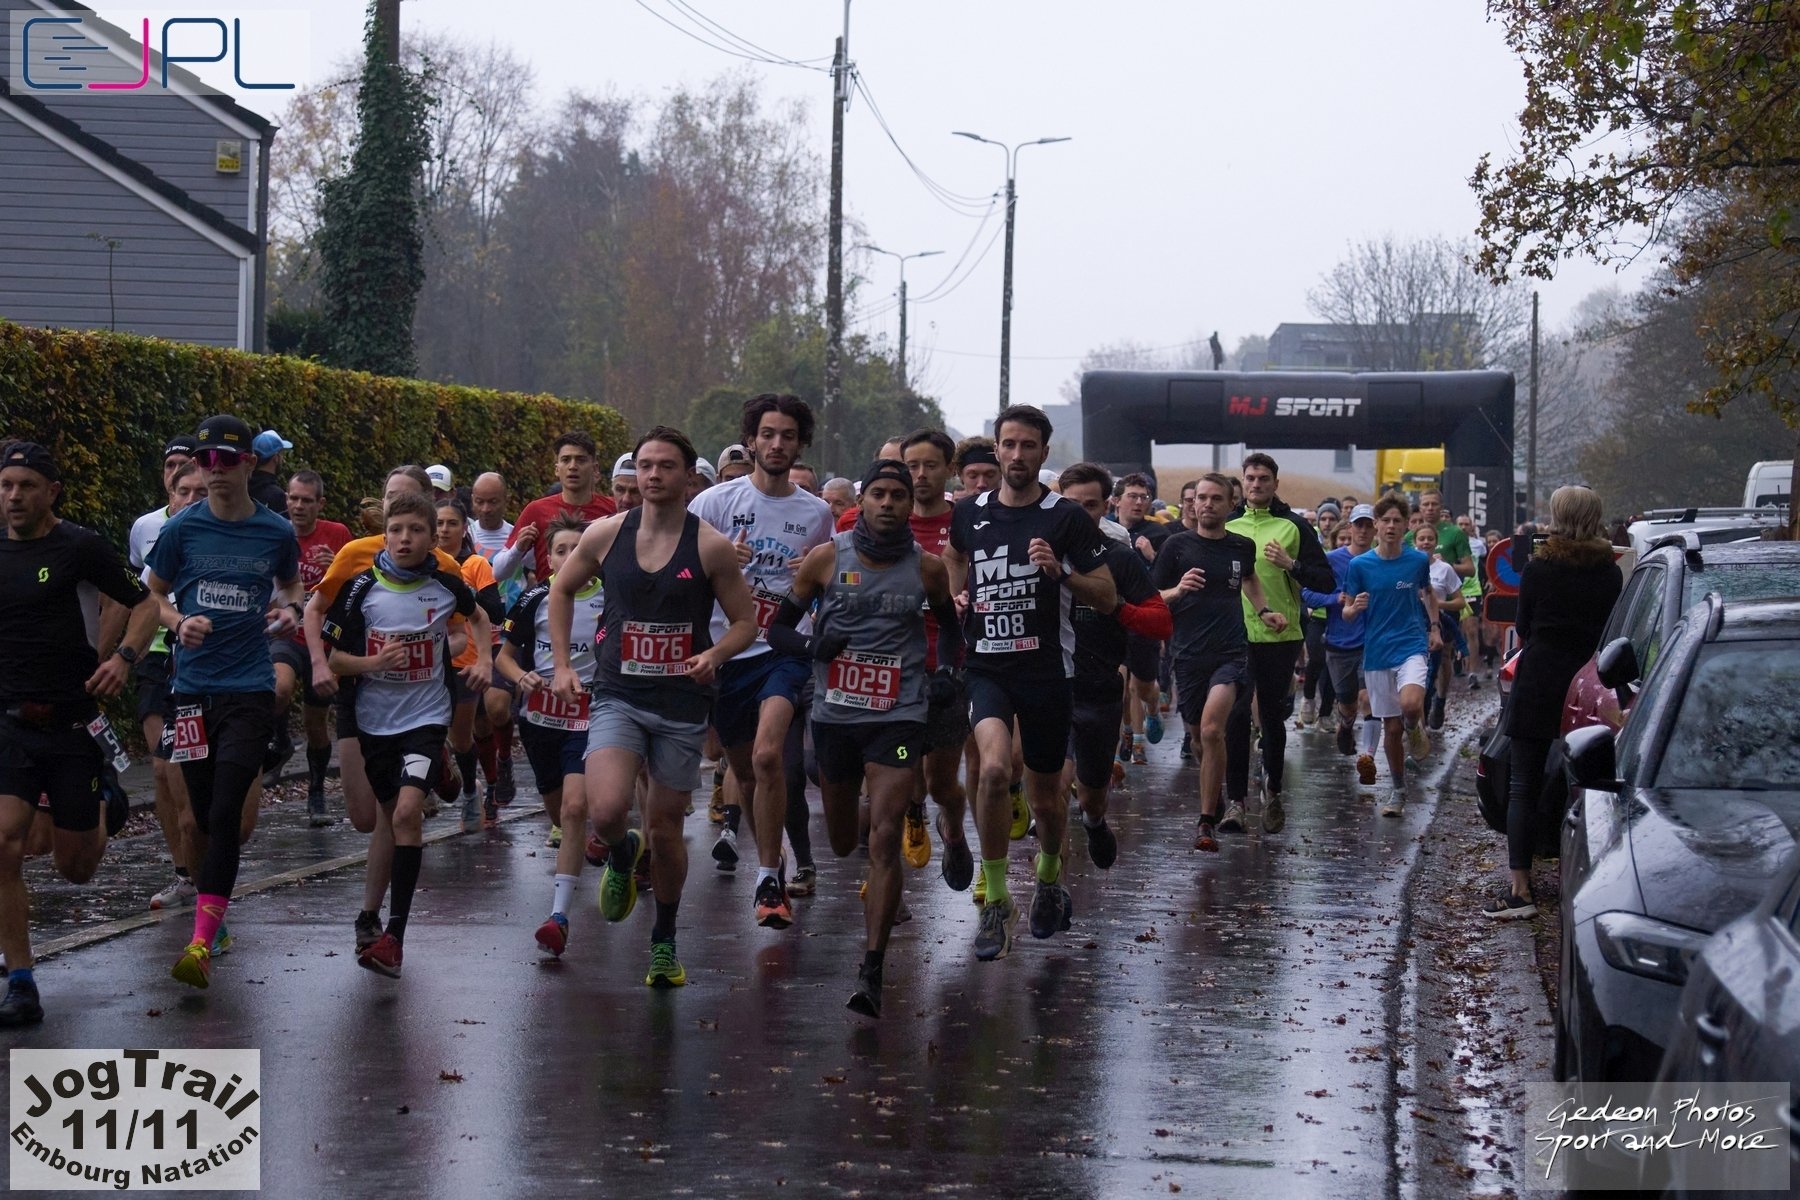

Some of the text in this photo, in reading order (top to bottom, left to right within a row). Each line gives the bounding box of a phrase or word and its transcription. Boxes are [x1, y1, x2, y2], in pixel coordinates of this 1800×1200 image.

[1228, 396, 1362, 417] MJ SPORT
[1468, 473, 1488, 527] ORT
[733, 512, 755, 527] MJ
[746, 536, 798, 558] ogTrai
[974, 545, 1040, 585] MJ
[756, 590, 784, 603] SPOR
[976, 577, 1040, 603] SPORT
[976, 600, 1032, 612] MJ SPORT
[371, 630, 386, 640] MJ
[626, 623, 689, 634] MJ SPORT
[984, 613, 1025, 638] 608
[630, 636, 684, 661] 1076
[1022, 639, 1036, 649] RTL
[855, 653, 899, 666] SPORT
[837, 663, 892, 695] 1029
[878, 699, 893, 709] RTL
[175, 720, 200, 747] 30
